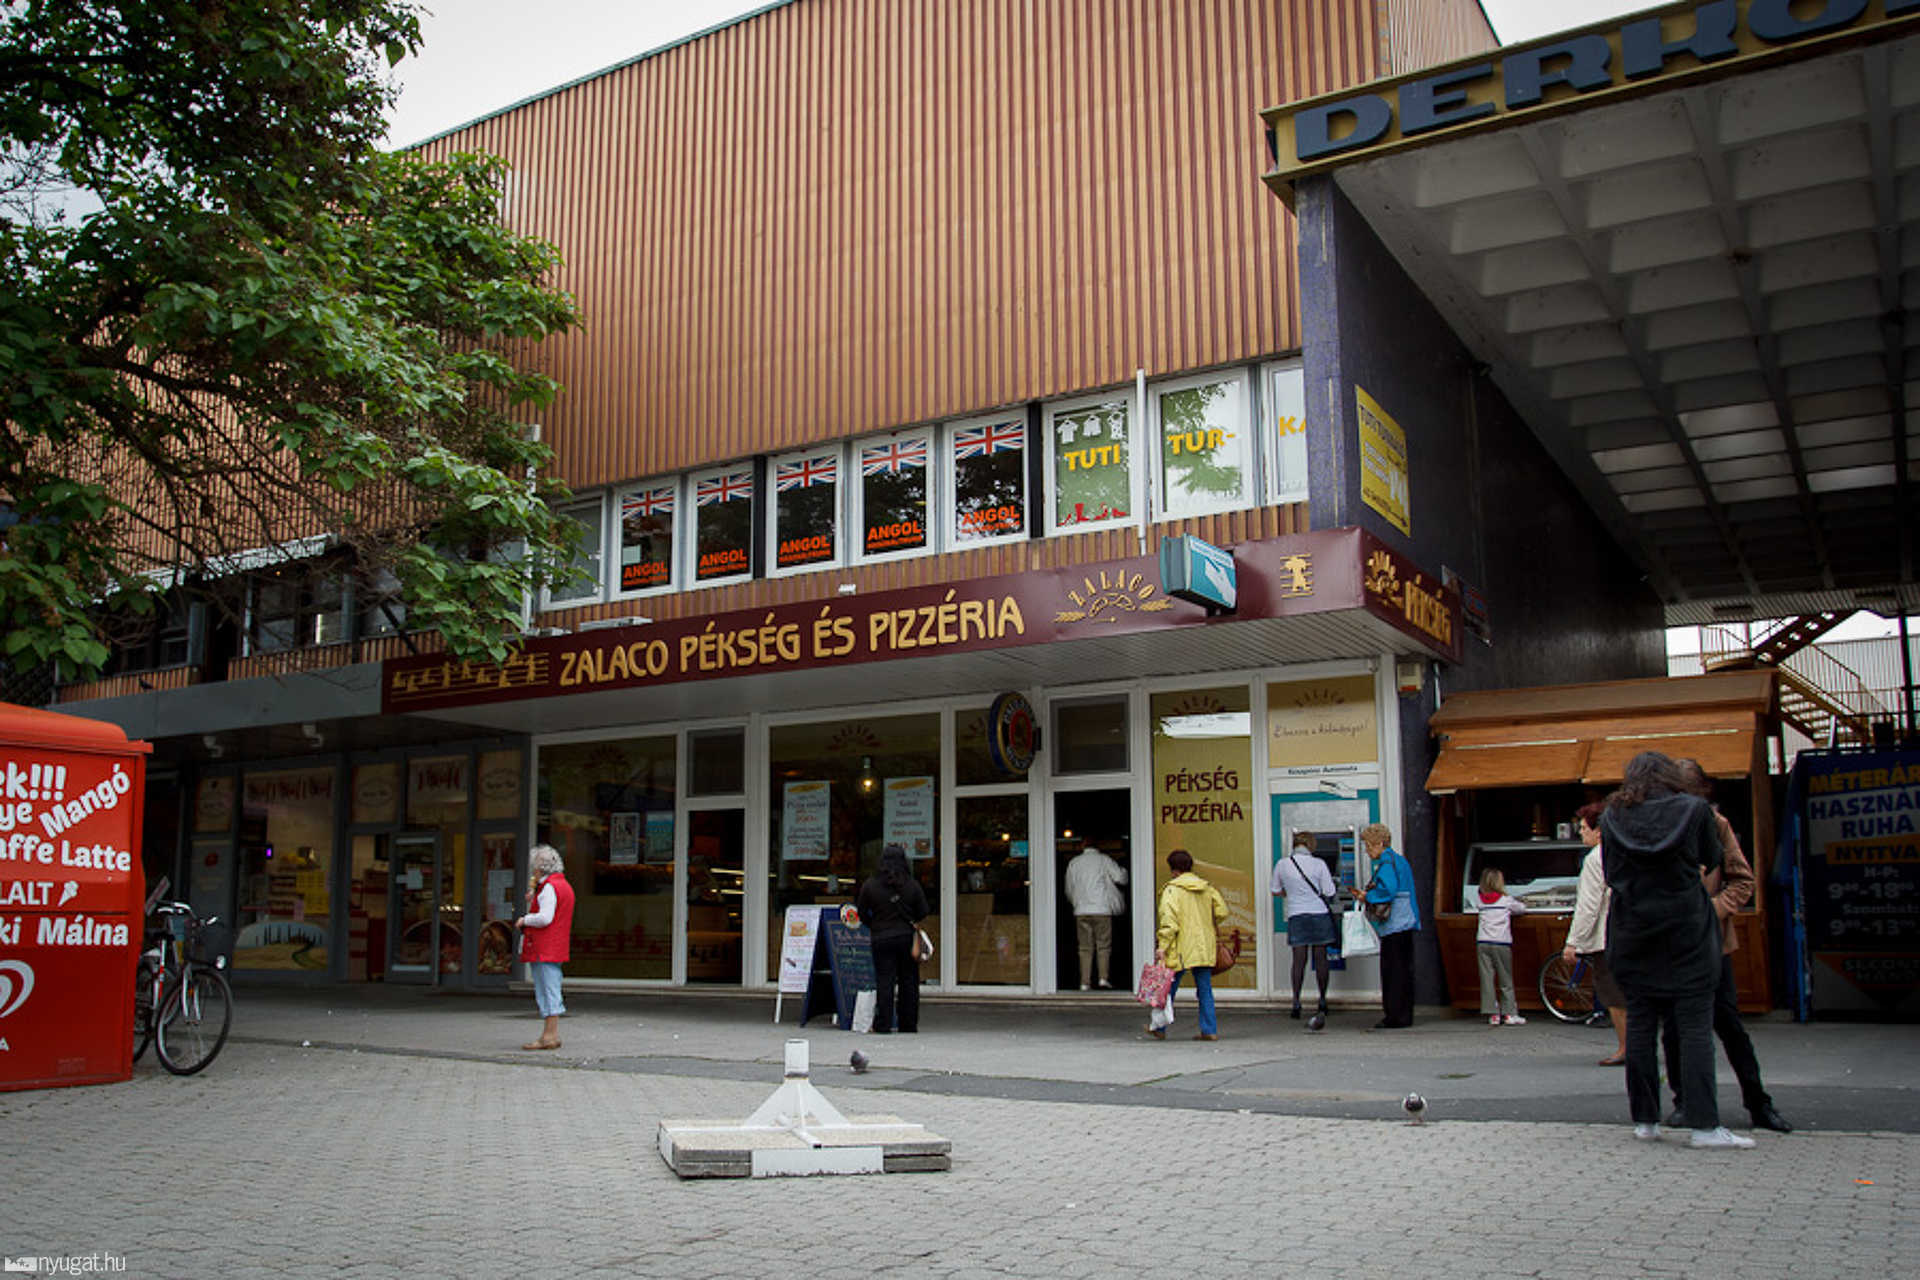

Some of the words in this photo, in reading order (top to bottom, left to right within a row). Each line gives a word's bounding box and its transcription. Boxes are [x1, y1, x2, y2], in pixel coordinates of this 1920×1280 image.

[1295, 0, 1920, 160] DERKO
[1168, 429, 1235, 455] TUR-
[1064, 444, 1121, 472] TUTI
[962, 505, 1020, 526] ANGOL
[867, 521, 922, 541] ANGOL
[778, 535, 831, 554] ANGOL
[624, 561, 668, 579] ANGOL
[699, 549, 748, 568] ANGOL
[560, 638, 667, 687] ZALACO
[680, 612, 800, 673] PÉKSÉG
[814, 607, 855, 659] ÉS
[869, 589, 1025, 653] PIZZÉRIA
[1165, 766, 1238, 792] PÉKSÉG
[39, 763, 131, 838] Mangó
[1162, 798, 1243, 824] PIZZÉRIA
[1841, 814, 1914, 839] RUHA
[61, 839, 131, 872] Latte
[37, 914, 129, 946] Málna
